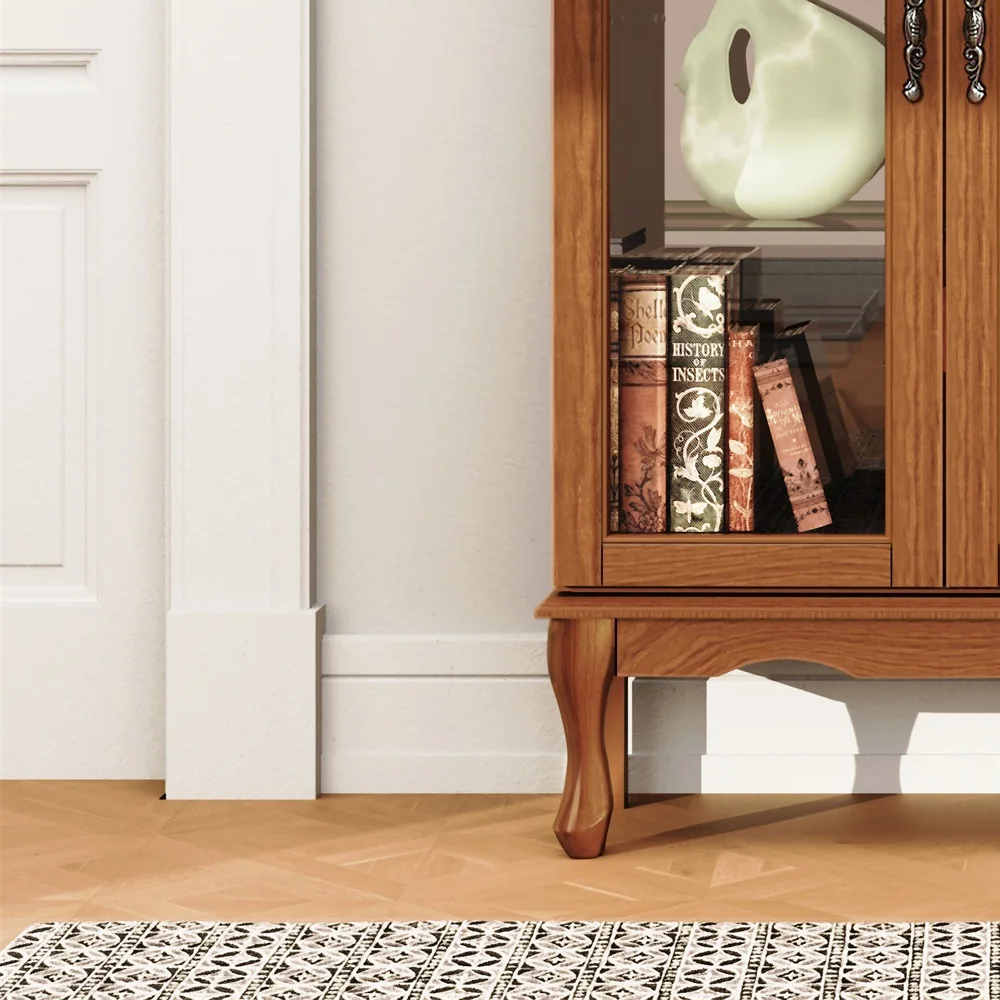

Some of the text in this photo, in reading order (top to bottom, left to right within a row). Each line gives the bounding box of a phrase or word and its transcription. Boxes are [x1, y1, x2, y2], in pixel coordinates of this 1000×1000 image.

[624, 296, 667, 321] Shell
[672, 342, 725, 357] HISTORY
[693, 358, 707, 367] OF
[672, 367, 725, 382] INSECTS
